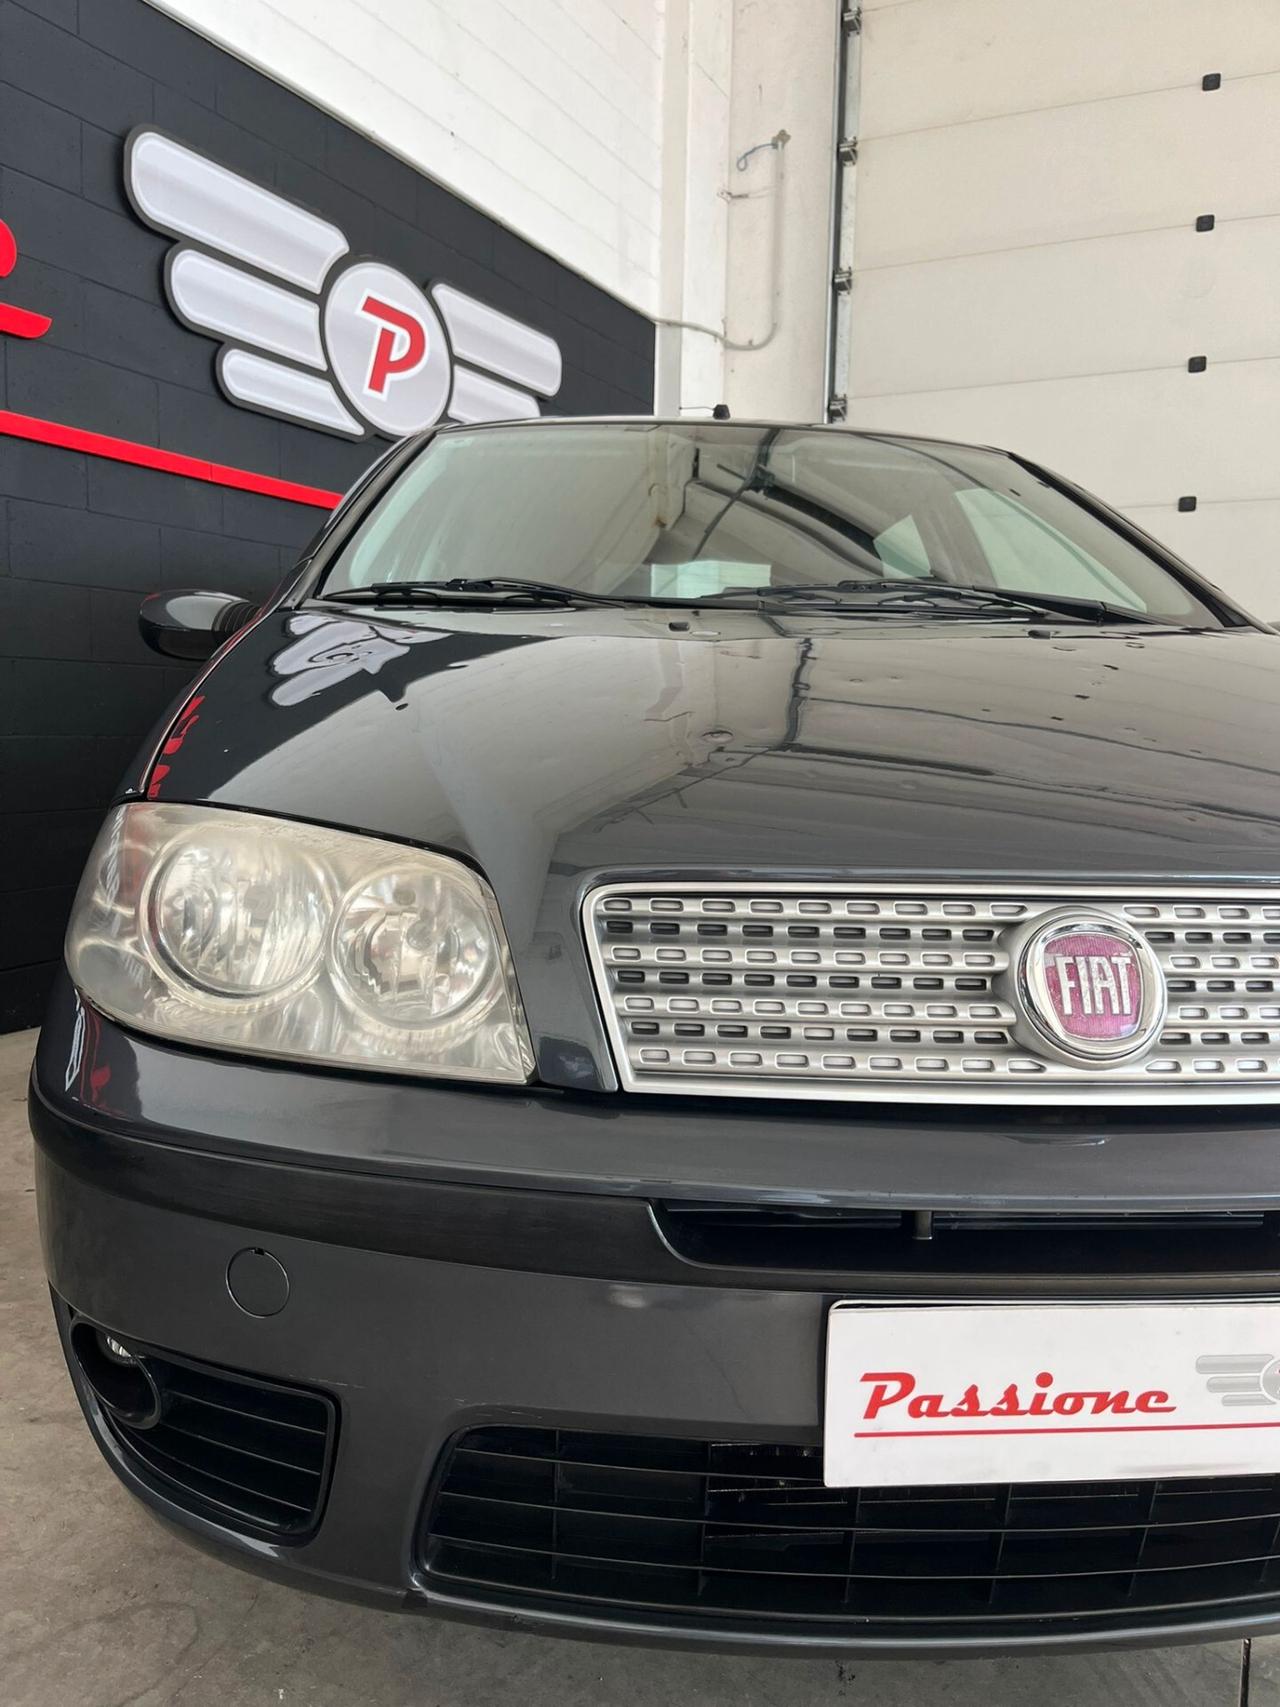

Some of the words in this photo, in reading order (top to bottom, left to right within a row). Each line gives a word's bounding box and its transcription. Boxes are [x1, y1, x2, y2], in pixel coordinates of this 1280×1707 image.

[362, 296, 426, 393] P
[1055, 955, 1132, 1016] FIAT
[860, 1371, 1176, 1420] Passione
